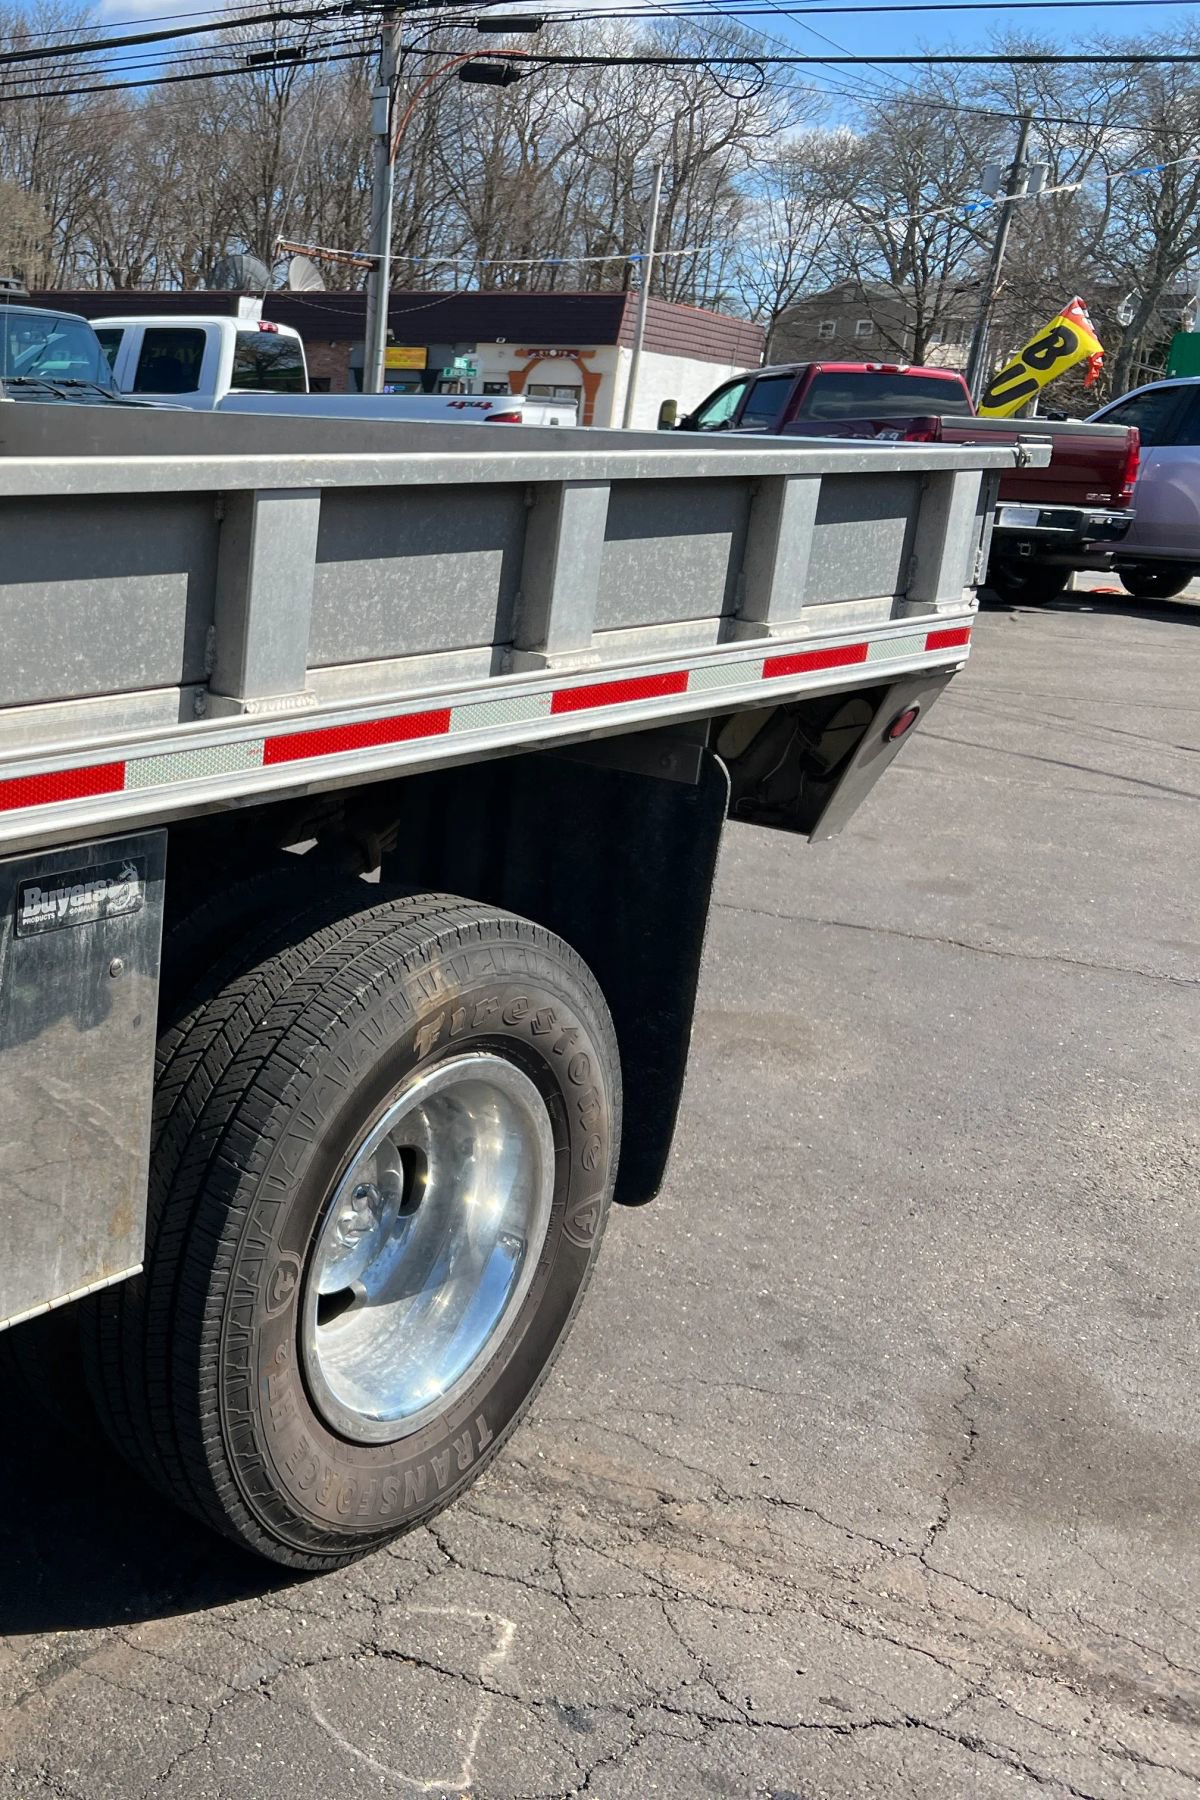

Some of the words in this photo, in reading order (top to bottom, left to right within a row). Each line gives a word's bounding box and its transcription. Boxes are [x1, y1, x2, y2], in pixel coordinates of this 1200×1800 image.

[22, 912, 56, 926] PRODUCTS
[68, 903, 99, 915] COMPANY
[23, 879, 108, 918] Buyers
[413, 995, 602, 1172] Firestone
[284, 1414, 494, 1517] TRANSFORCE
